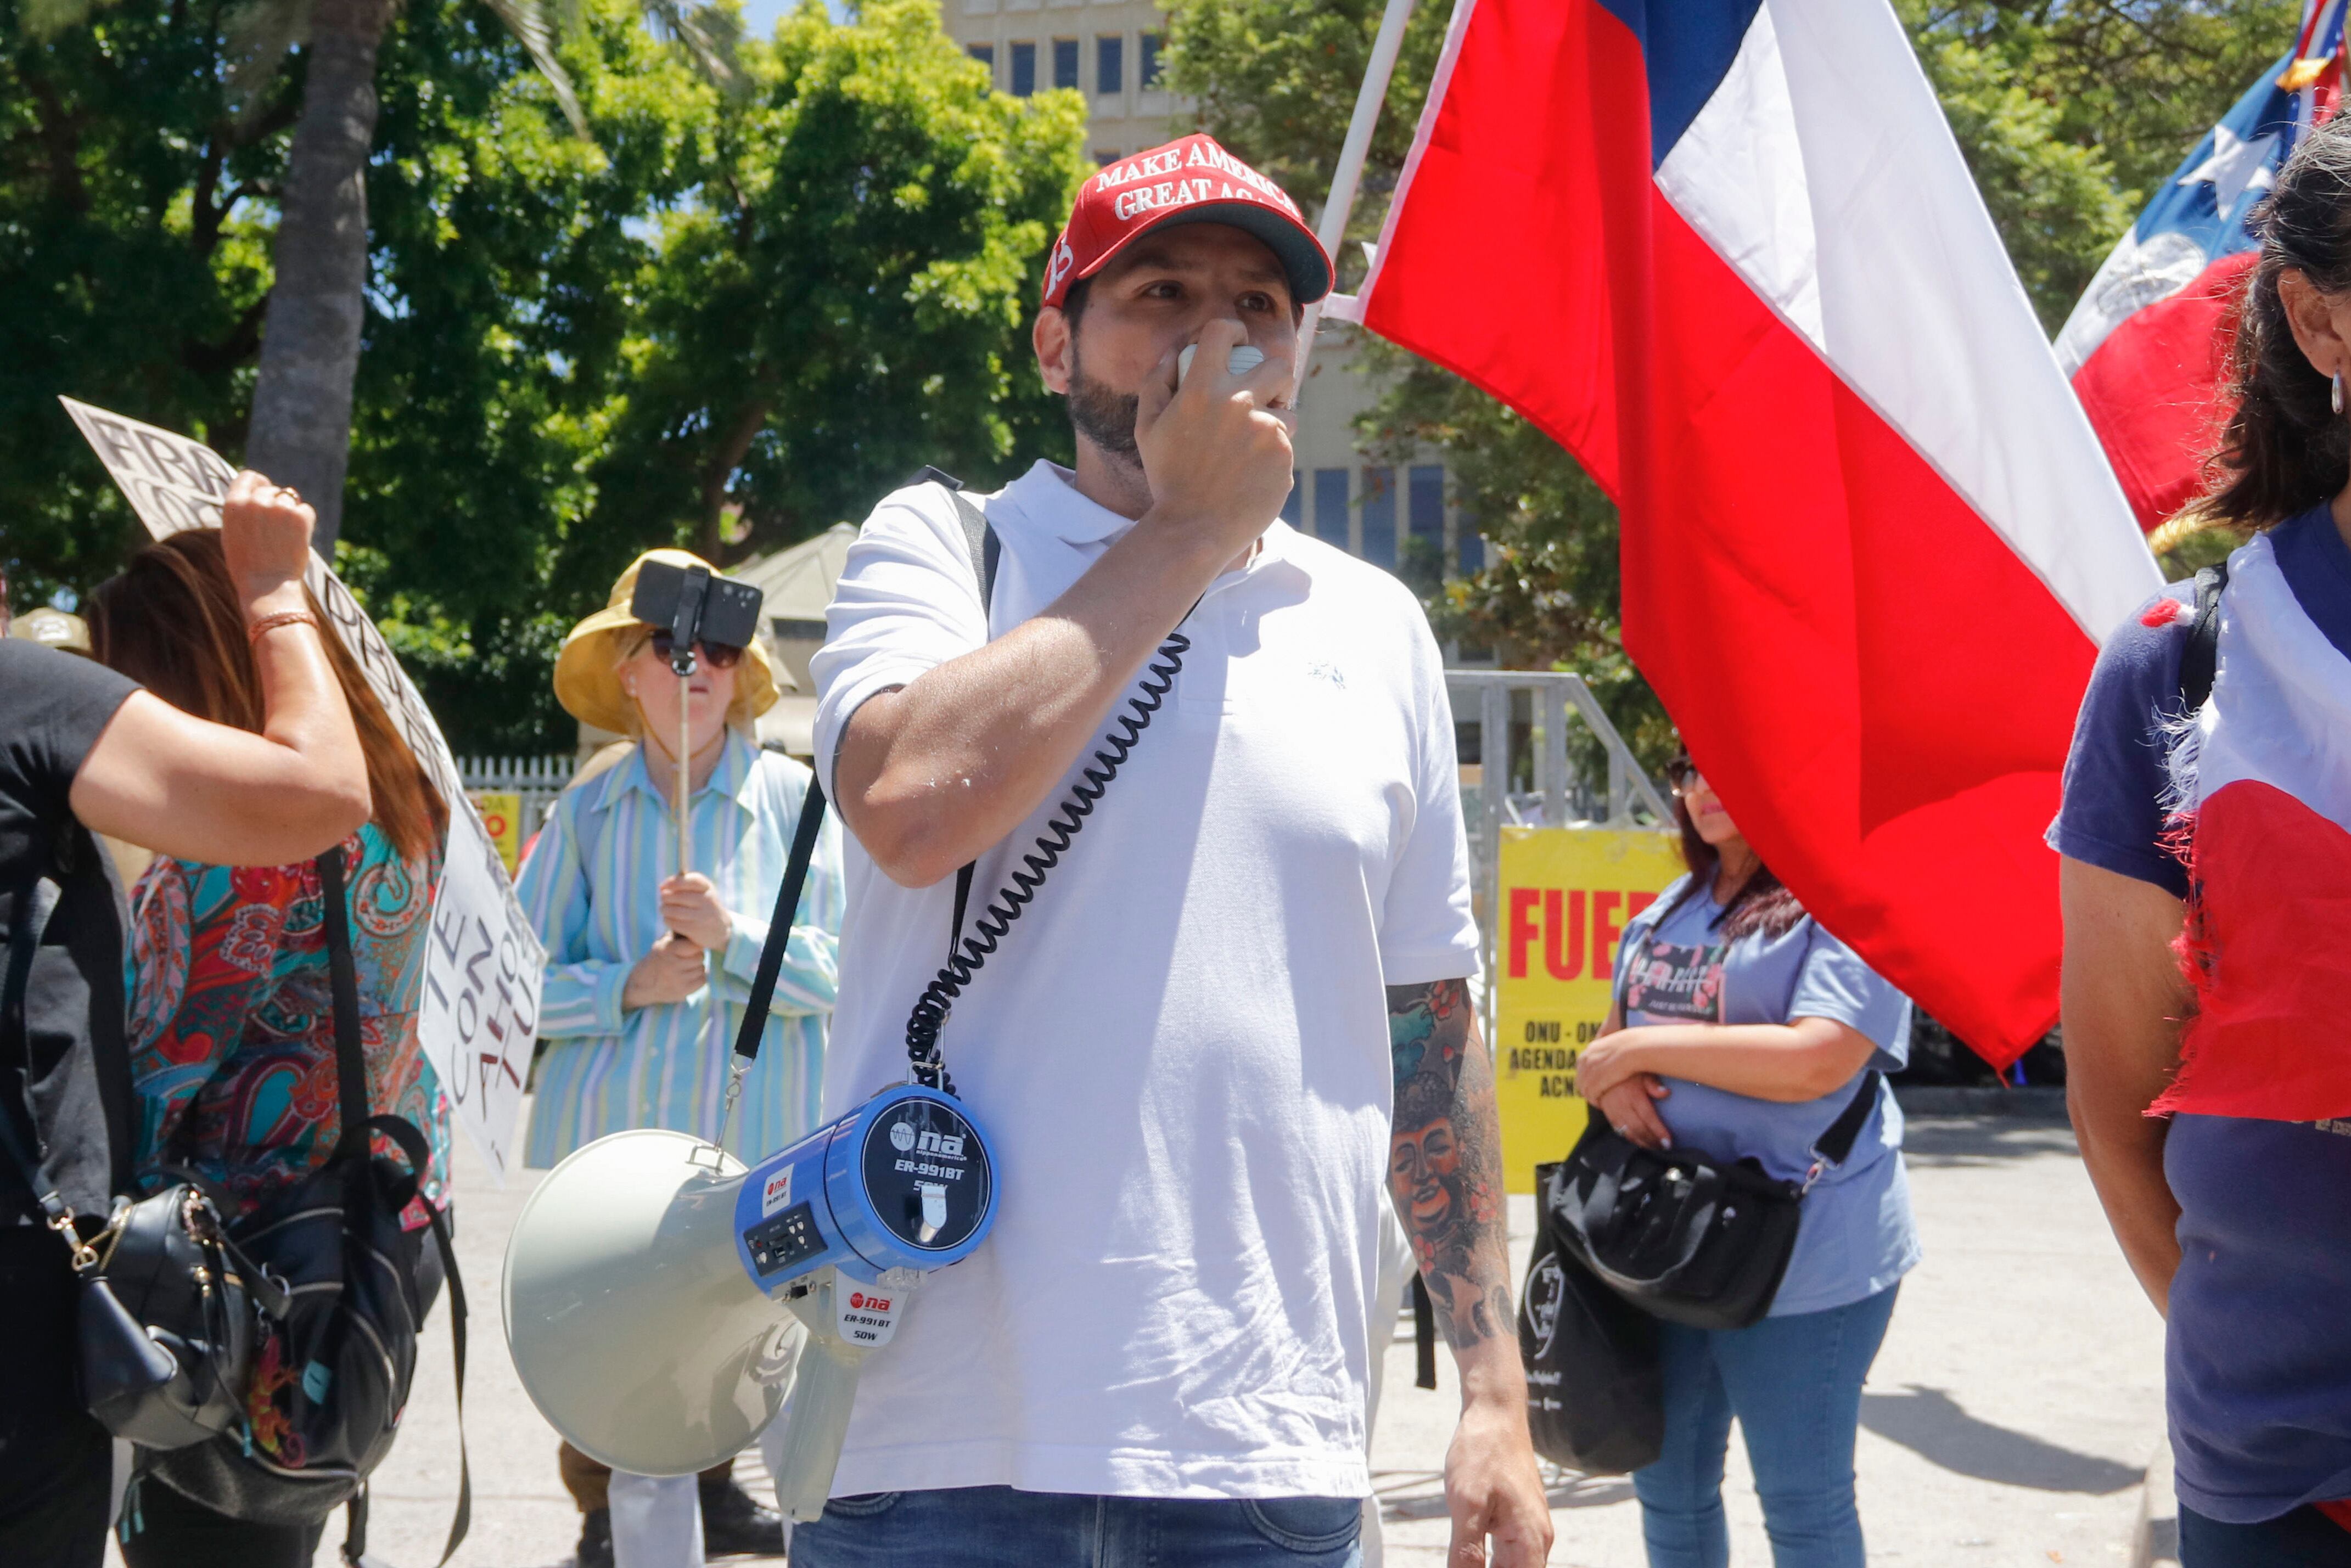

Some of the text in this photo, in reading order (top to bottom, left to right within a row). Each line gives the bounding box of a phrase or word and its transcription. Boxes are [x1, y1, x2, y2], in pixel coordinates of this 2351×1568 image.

[1096, 142, 1299, 217] MAKE AMERICA
[1115, 179, 1212, 221] GREAT
[452, 914, 493, 1105] CON
[1525, 1022, 1560, 1042] ONU
[1510, 1048, 1576, 1070] AGENDA
[895, 1159, 964, 1180] ER-991BT
[854, 1330, 877, 1340] 50W
